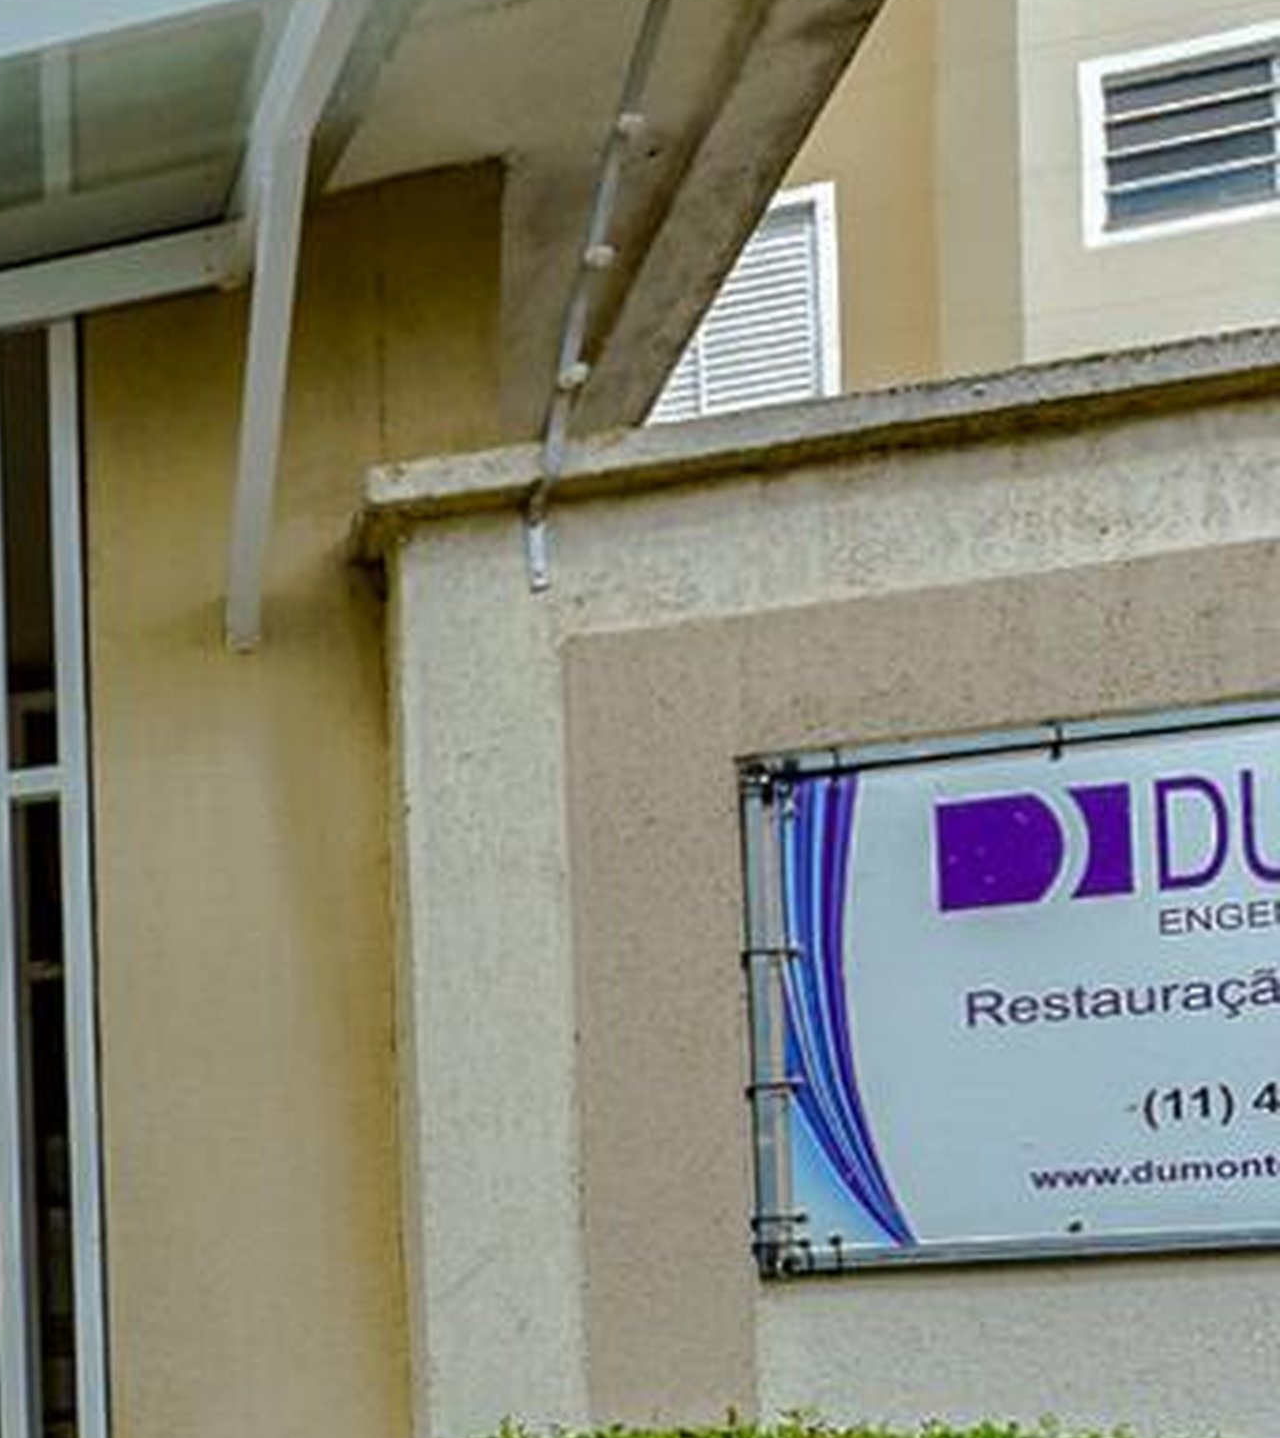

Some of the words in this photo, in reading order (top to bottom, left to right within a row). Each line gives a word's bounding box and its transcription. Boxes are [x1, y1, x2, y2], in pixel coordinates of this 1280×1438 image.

[1154, 769, 1280, 891] DU
[1159, 900, 1280, 936] ENGE
[966, 967, 1280, 1029] Restauraçã
[1143, 1083, 1234, 1130] (11)
[1252, 1081, 1280, 1113] 4
[1030, 1154, 1280, 1190] www.dumont
